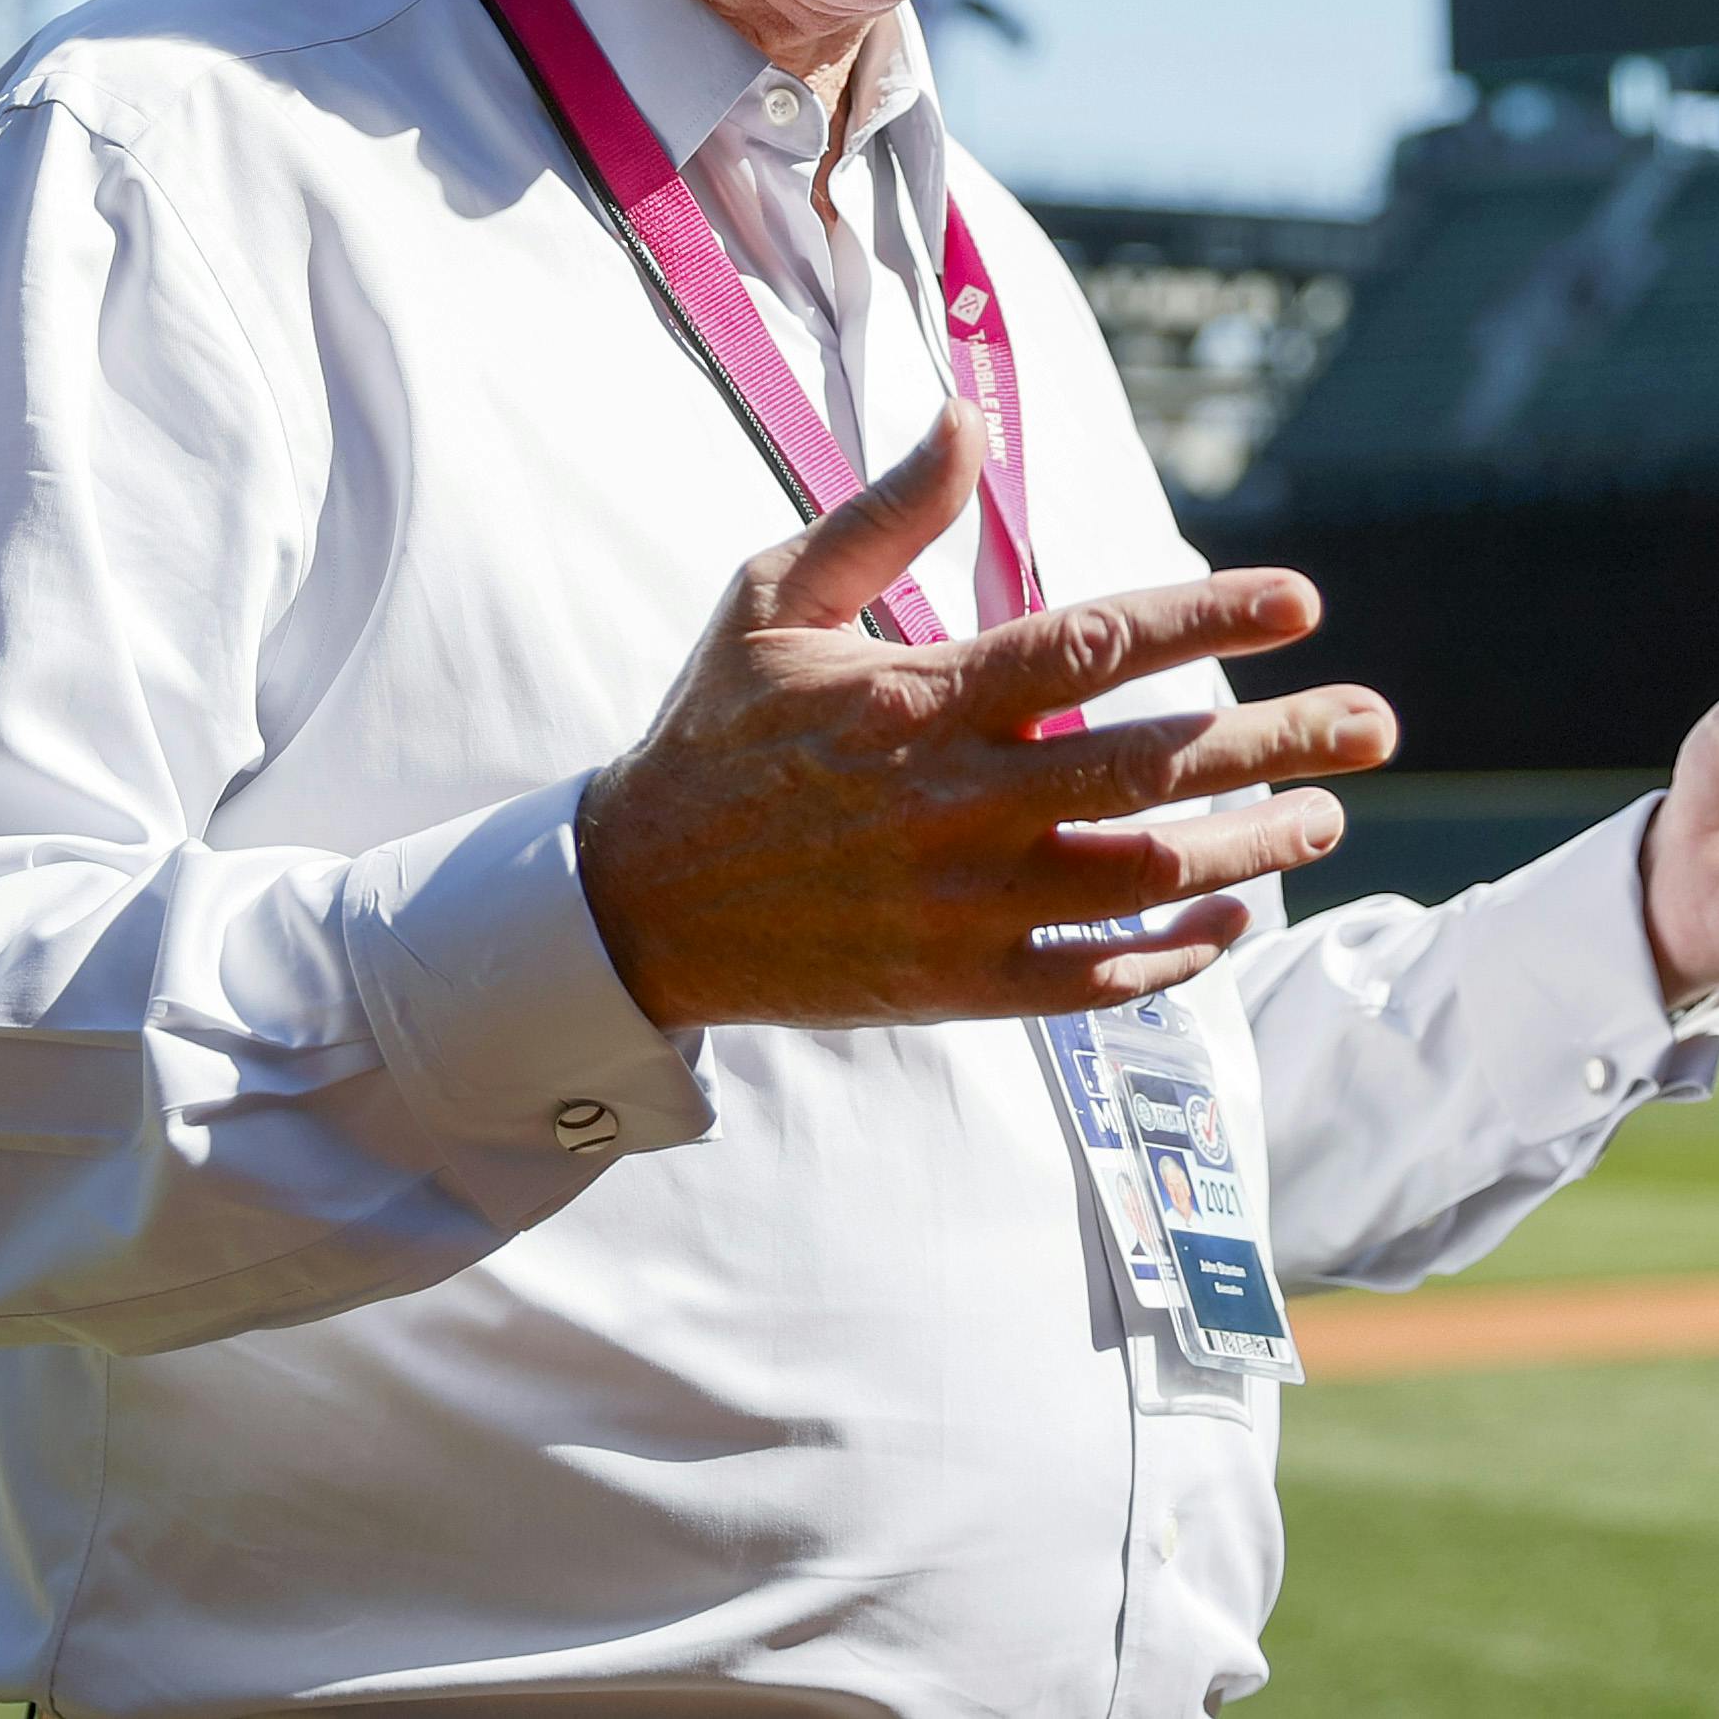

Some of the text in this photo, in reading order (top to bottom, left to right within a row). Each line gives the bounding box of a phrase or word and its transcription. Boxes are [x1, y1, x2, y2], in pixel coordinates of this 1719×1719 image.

[967, 329, 1008, 467] T-MOBILE PARK
[1200, 1180, 1243, 1217] 2021
